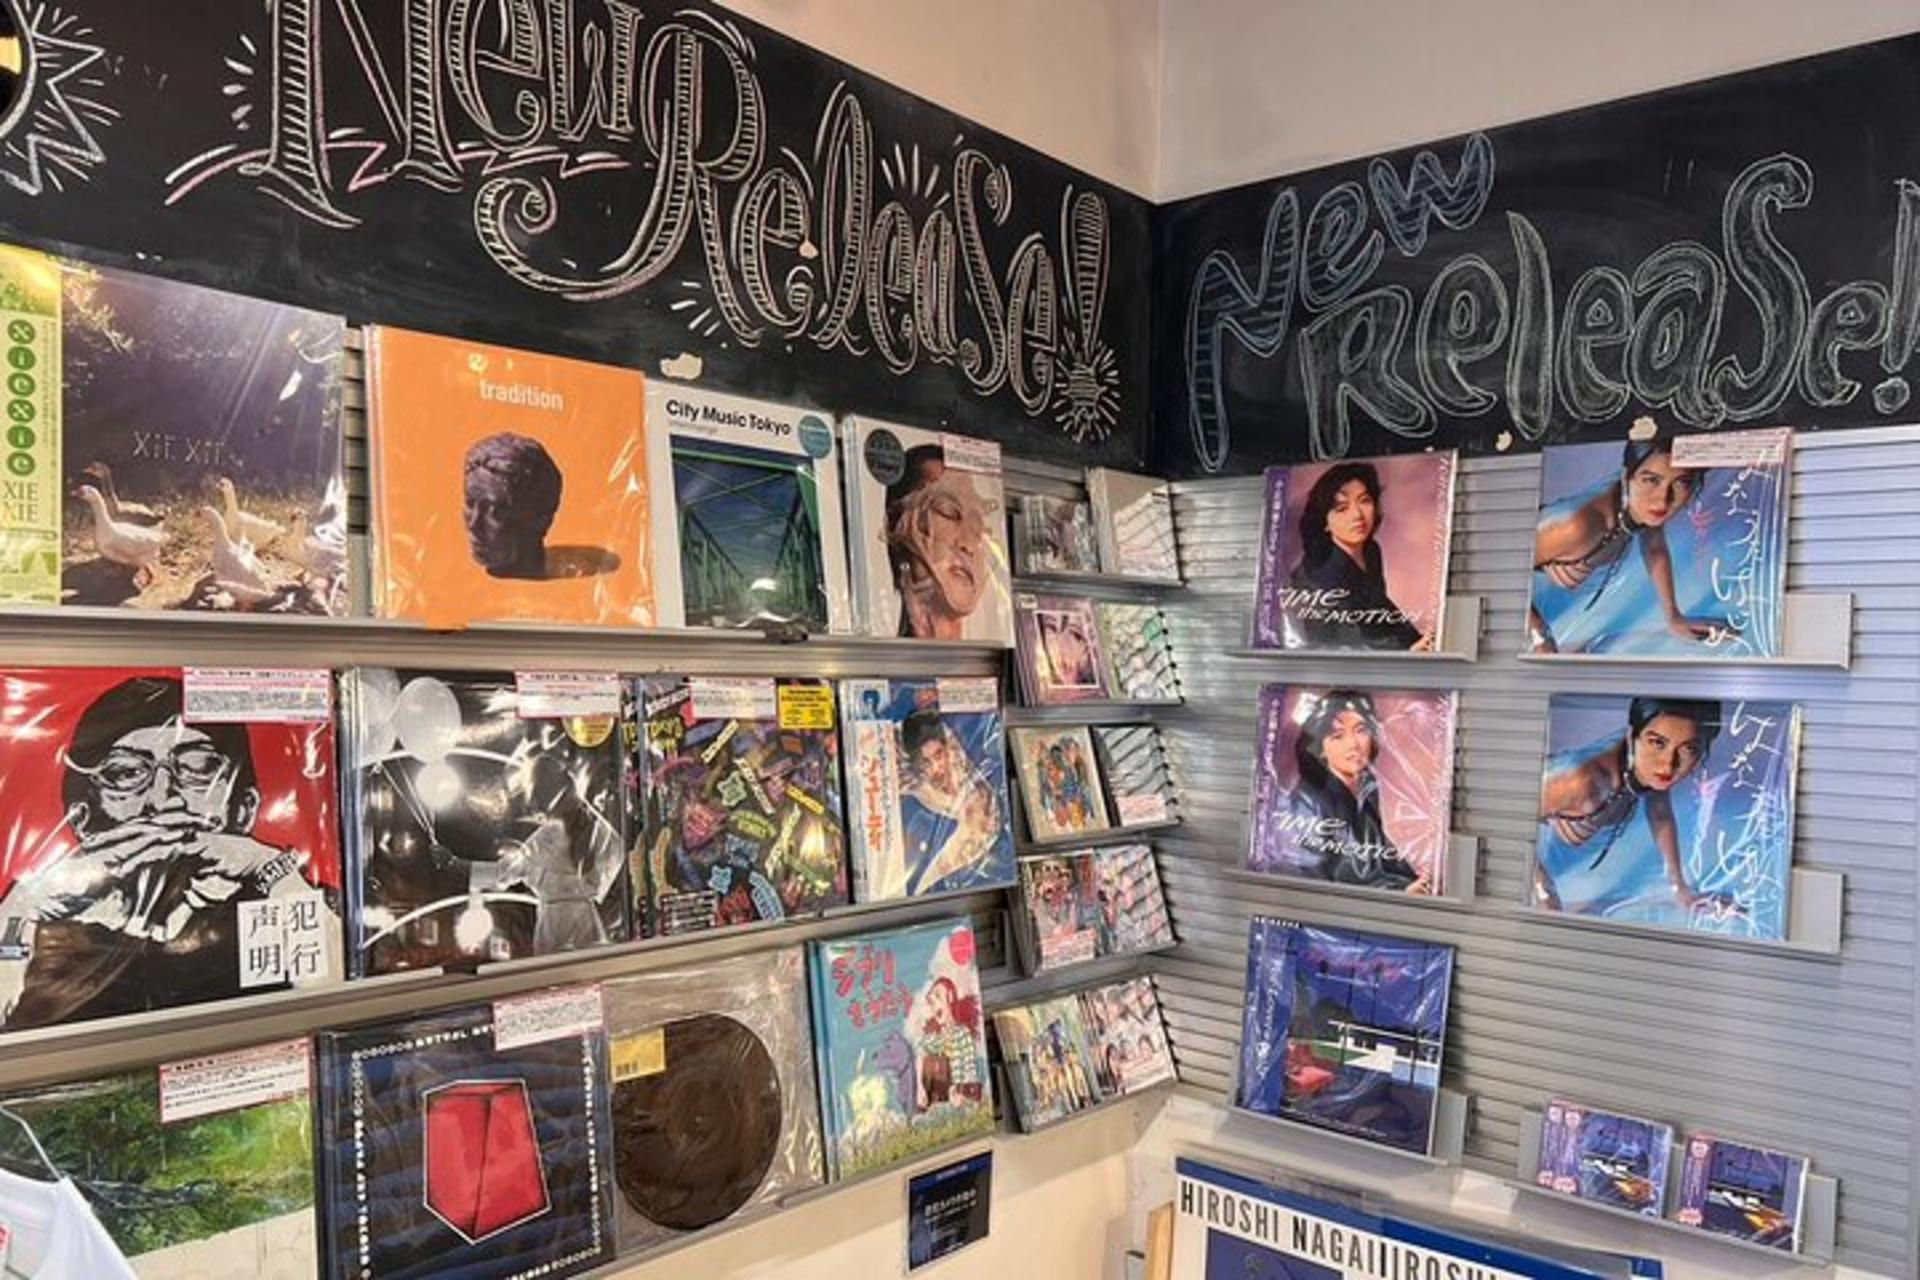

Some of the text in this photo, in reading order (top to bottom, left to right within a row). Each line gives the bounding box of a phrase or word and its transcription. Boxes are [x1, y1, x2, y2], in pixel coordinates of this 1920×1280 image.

[480, 379, 564, 411] tradition
[666, 400, 700, 421] City
[702, 406, 747, 427] Music
[750, 414, 792, 435] Tokyo
[249, 905, 281, 978] 声明
[288, 900, 320, 976] 犯行
[1180, 1180, 1279, 1244] HIROSHI
[1292, 1215, 1374, 1274] NAGAI
